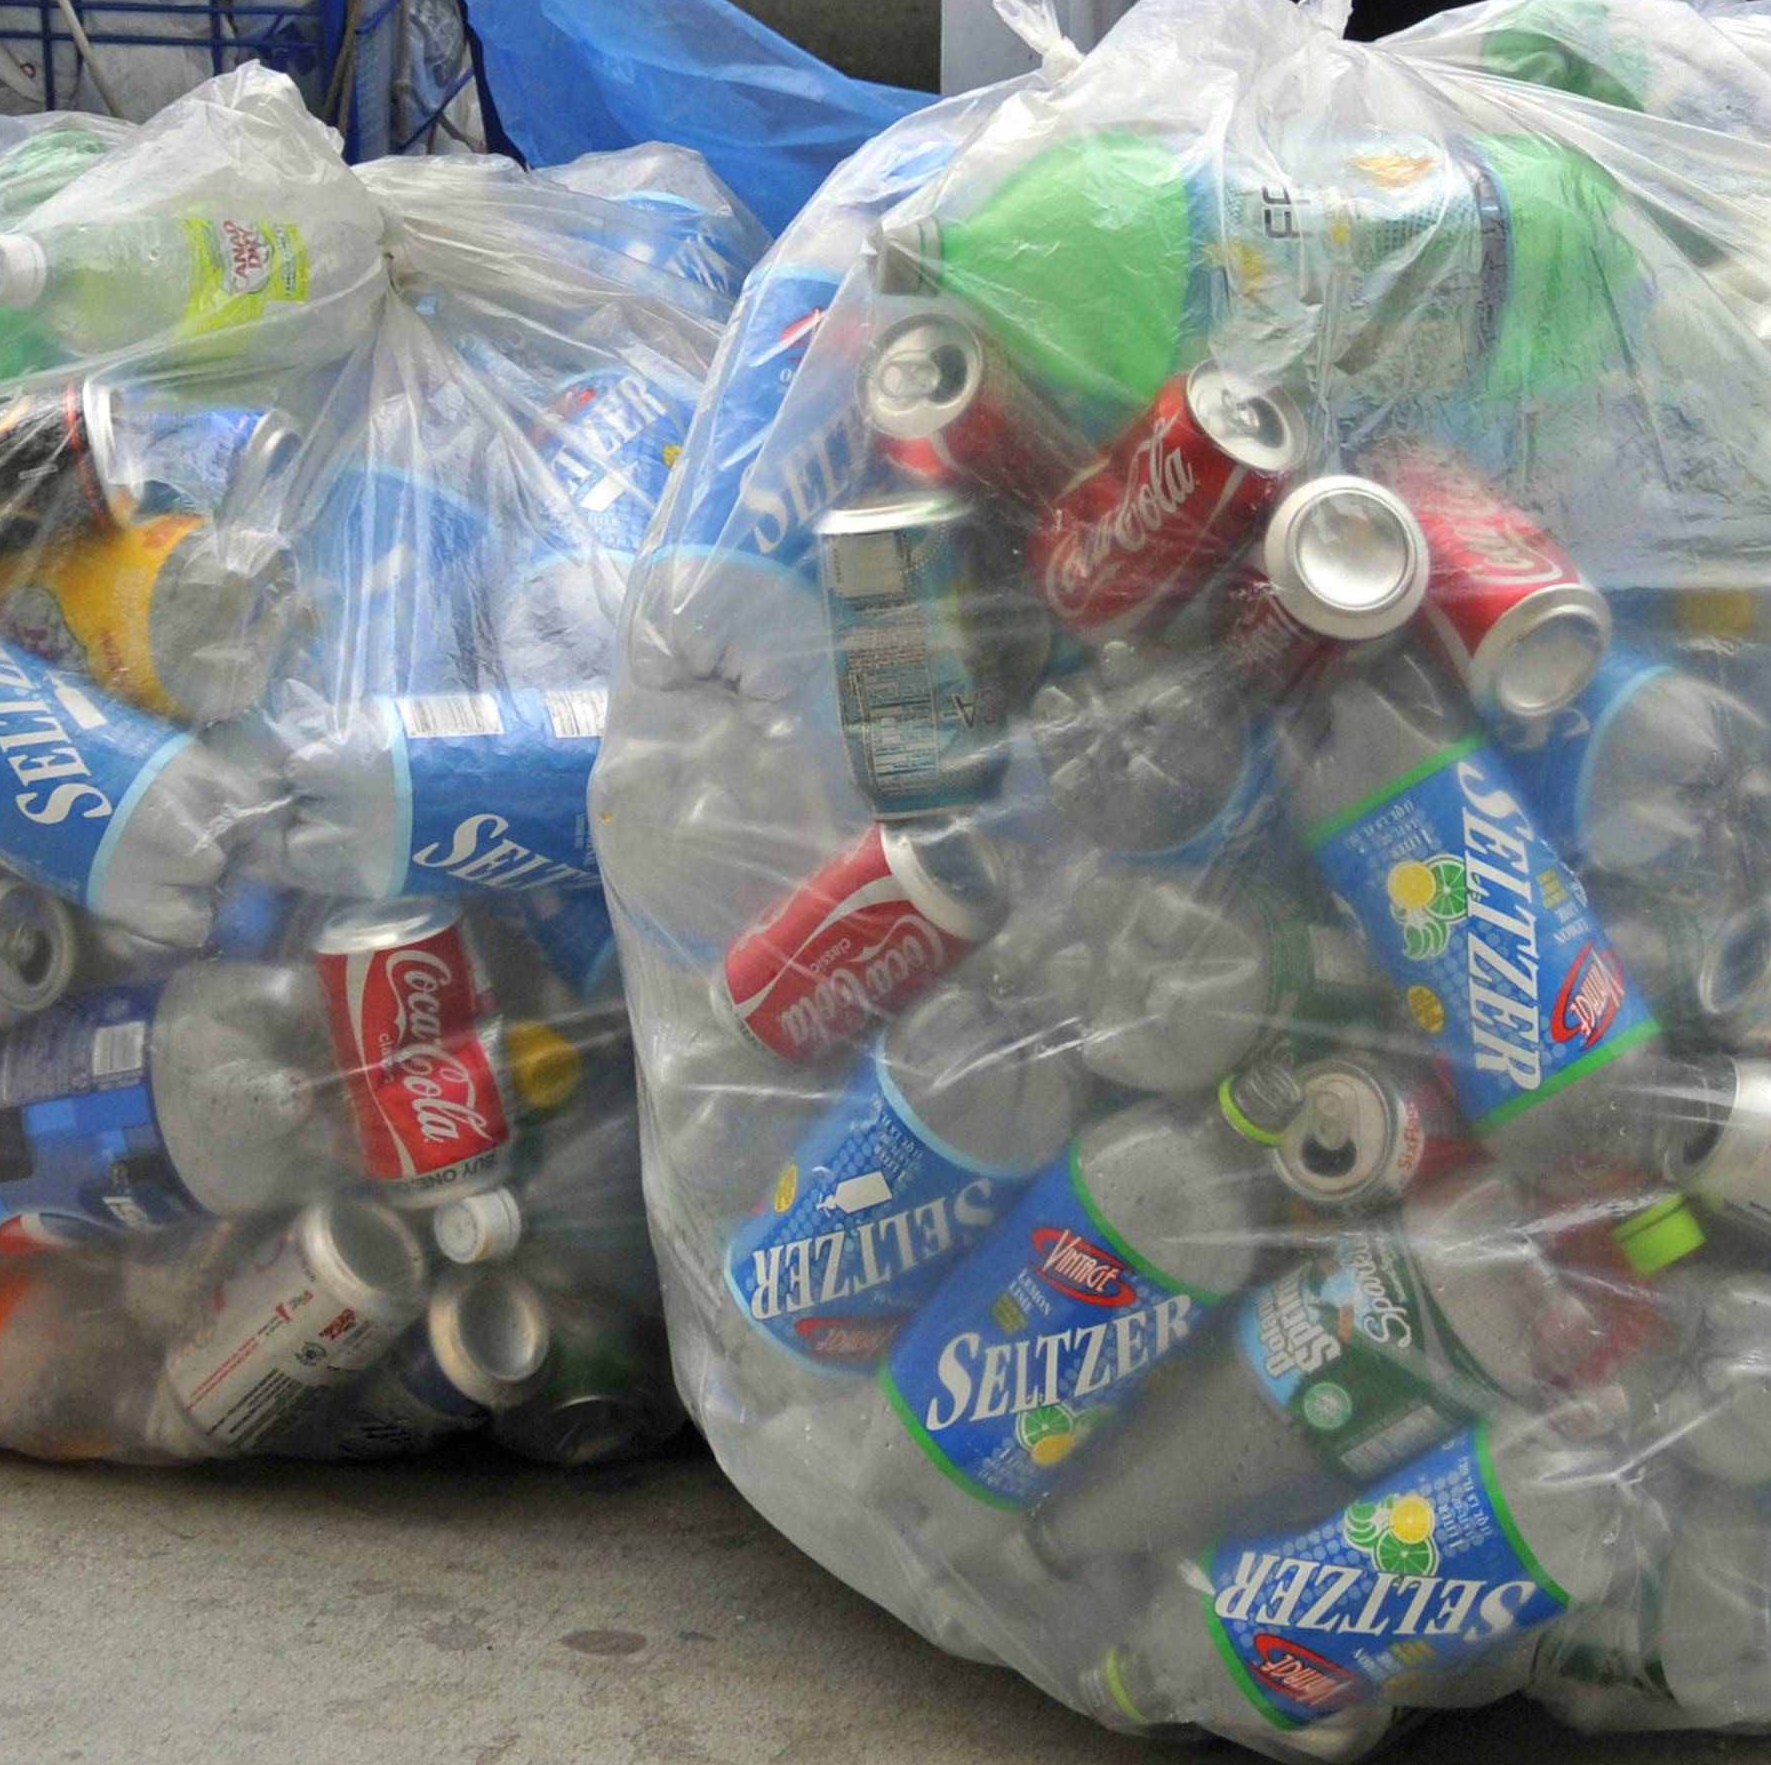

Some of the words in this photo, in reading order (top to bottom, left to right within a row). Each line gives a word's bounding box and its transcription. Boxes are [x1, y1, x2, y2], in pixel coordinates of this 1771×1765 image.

[412, 812, 602, 893] SELT
[810, 936, 853, 975] classic
[1456, 760, 1543, 1092] SELTZER
[1567, 950, 1626, 1039] VINTAGE
[749, 1176, 995, 1322] SELTZER
[1017, 1268, 1054, 1317] LEMON
[1042, 1230, 1122, 1296] VINTAGE
[925, 1292, 1194, 1433] SELTZER
[1214, 1549, 1538, 1644] SELTZER
